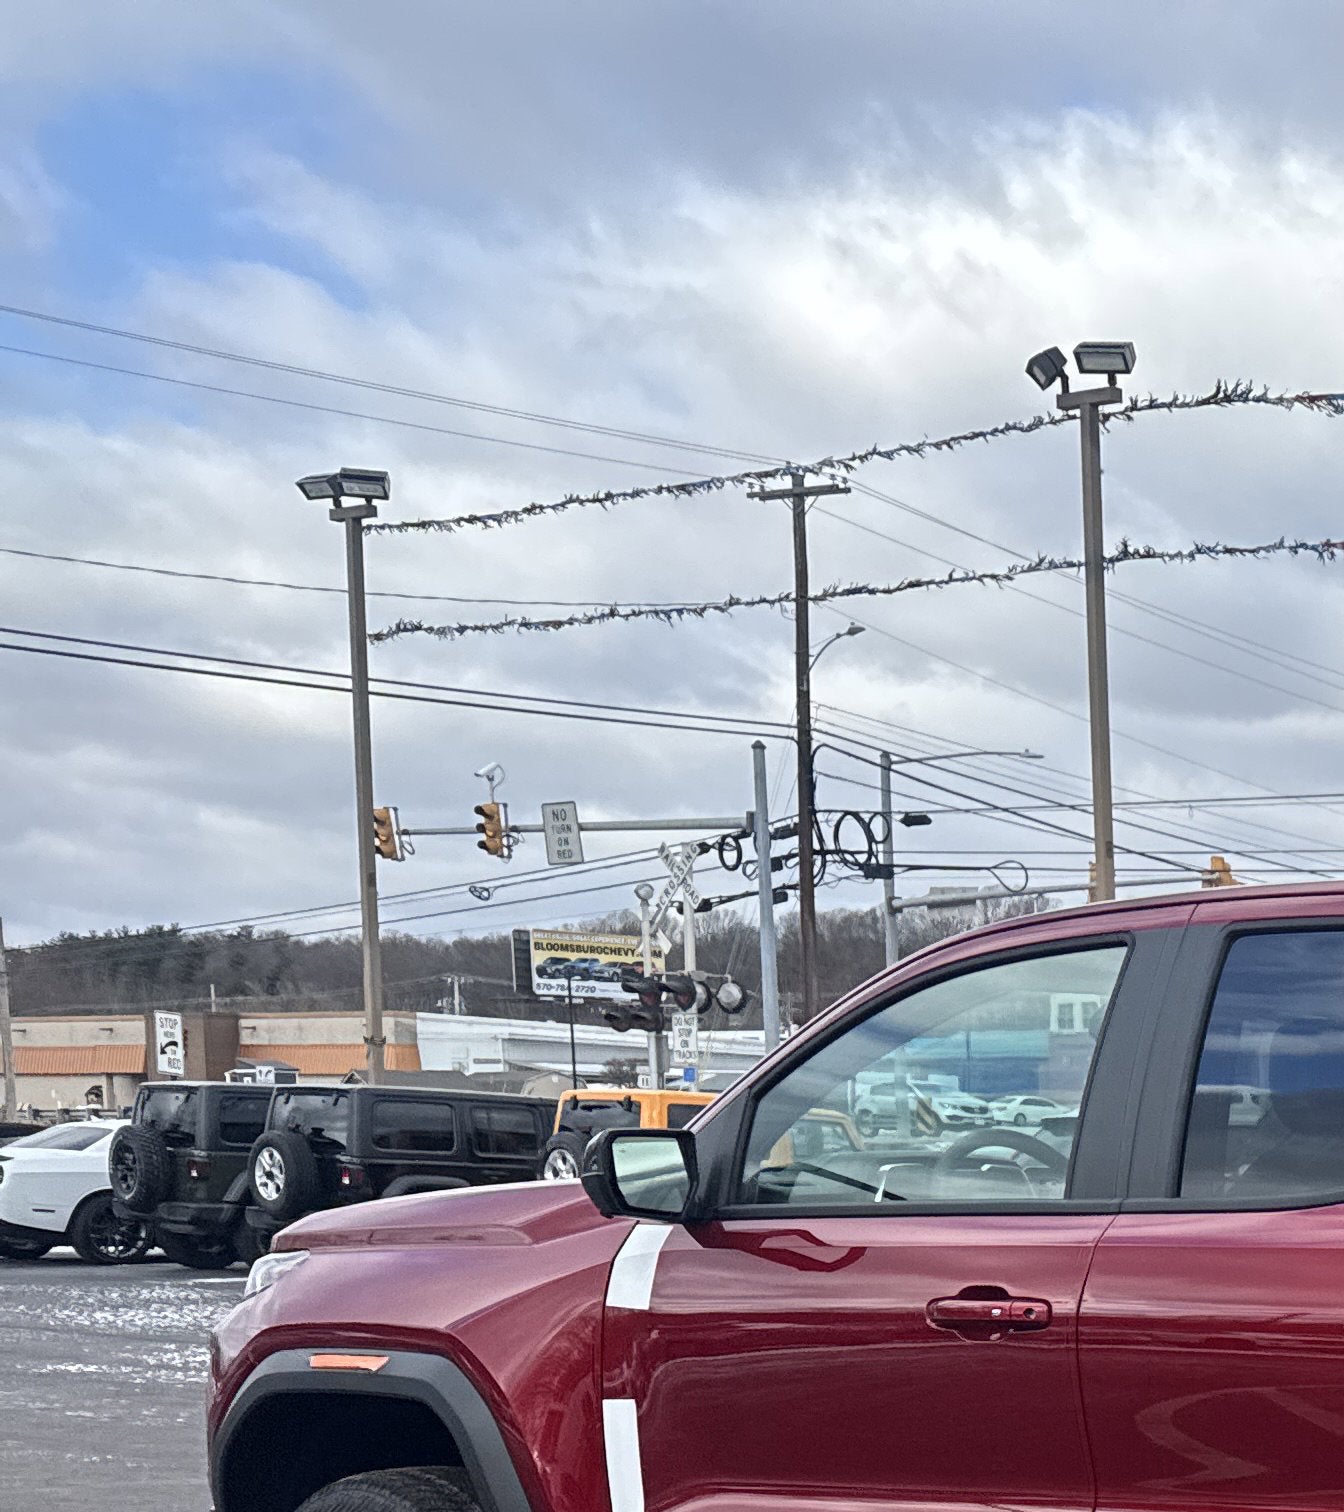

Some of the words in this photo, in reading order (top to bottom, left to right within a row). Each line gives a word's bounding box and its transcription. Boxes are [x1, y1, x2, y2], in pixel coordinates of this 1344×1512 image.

[552, 808, 567, 821] NO
[552, 823, 572, 834] TURN
[557, 836, 570, 847] ON
[557, 848, 573, 859] RED
[659, 843, 698, 906] CROSSING
[534, 941, 662, 959] BLOOMSBURGCHEVY.M
[159, 1016, 178, 1030] STOP
[167, 1057, 182, 1070] RED
